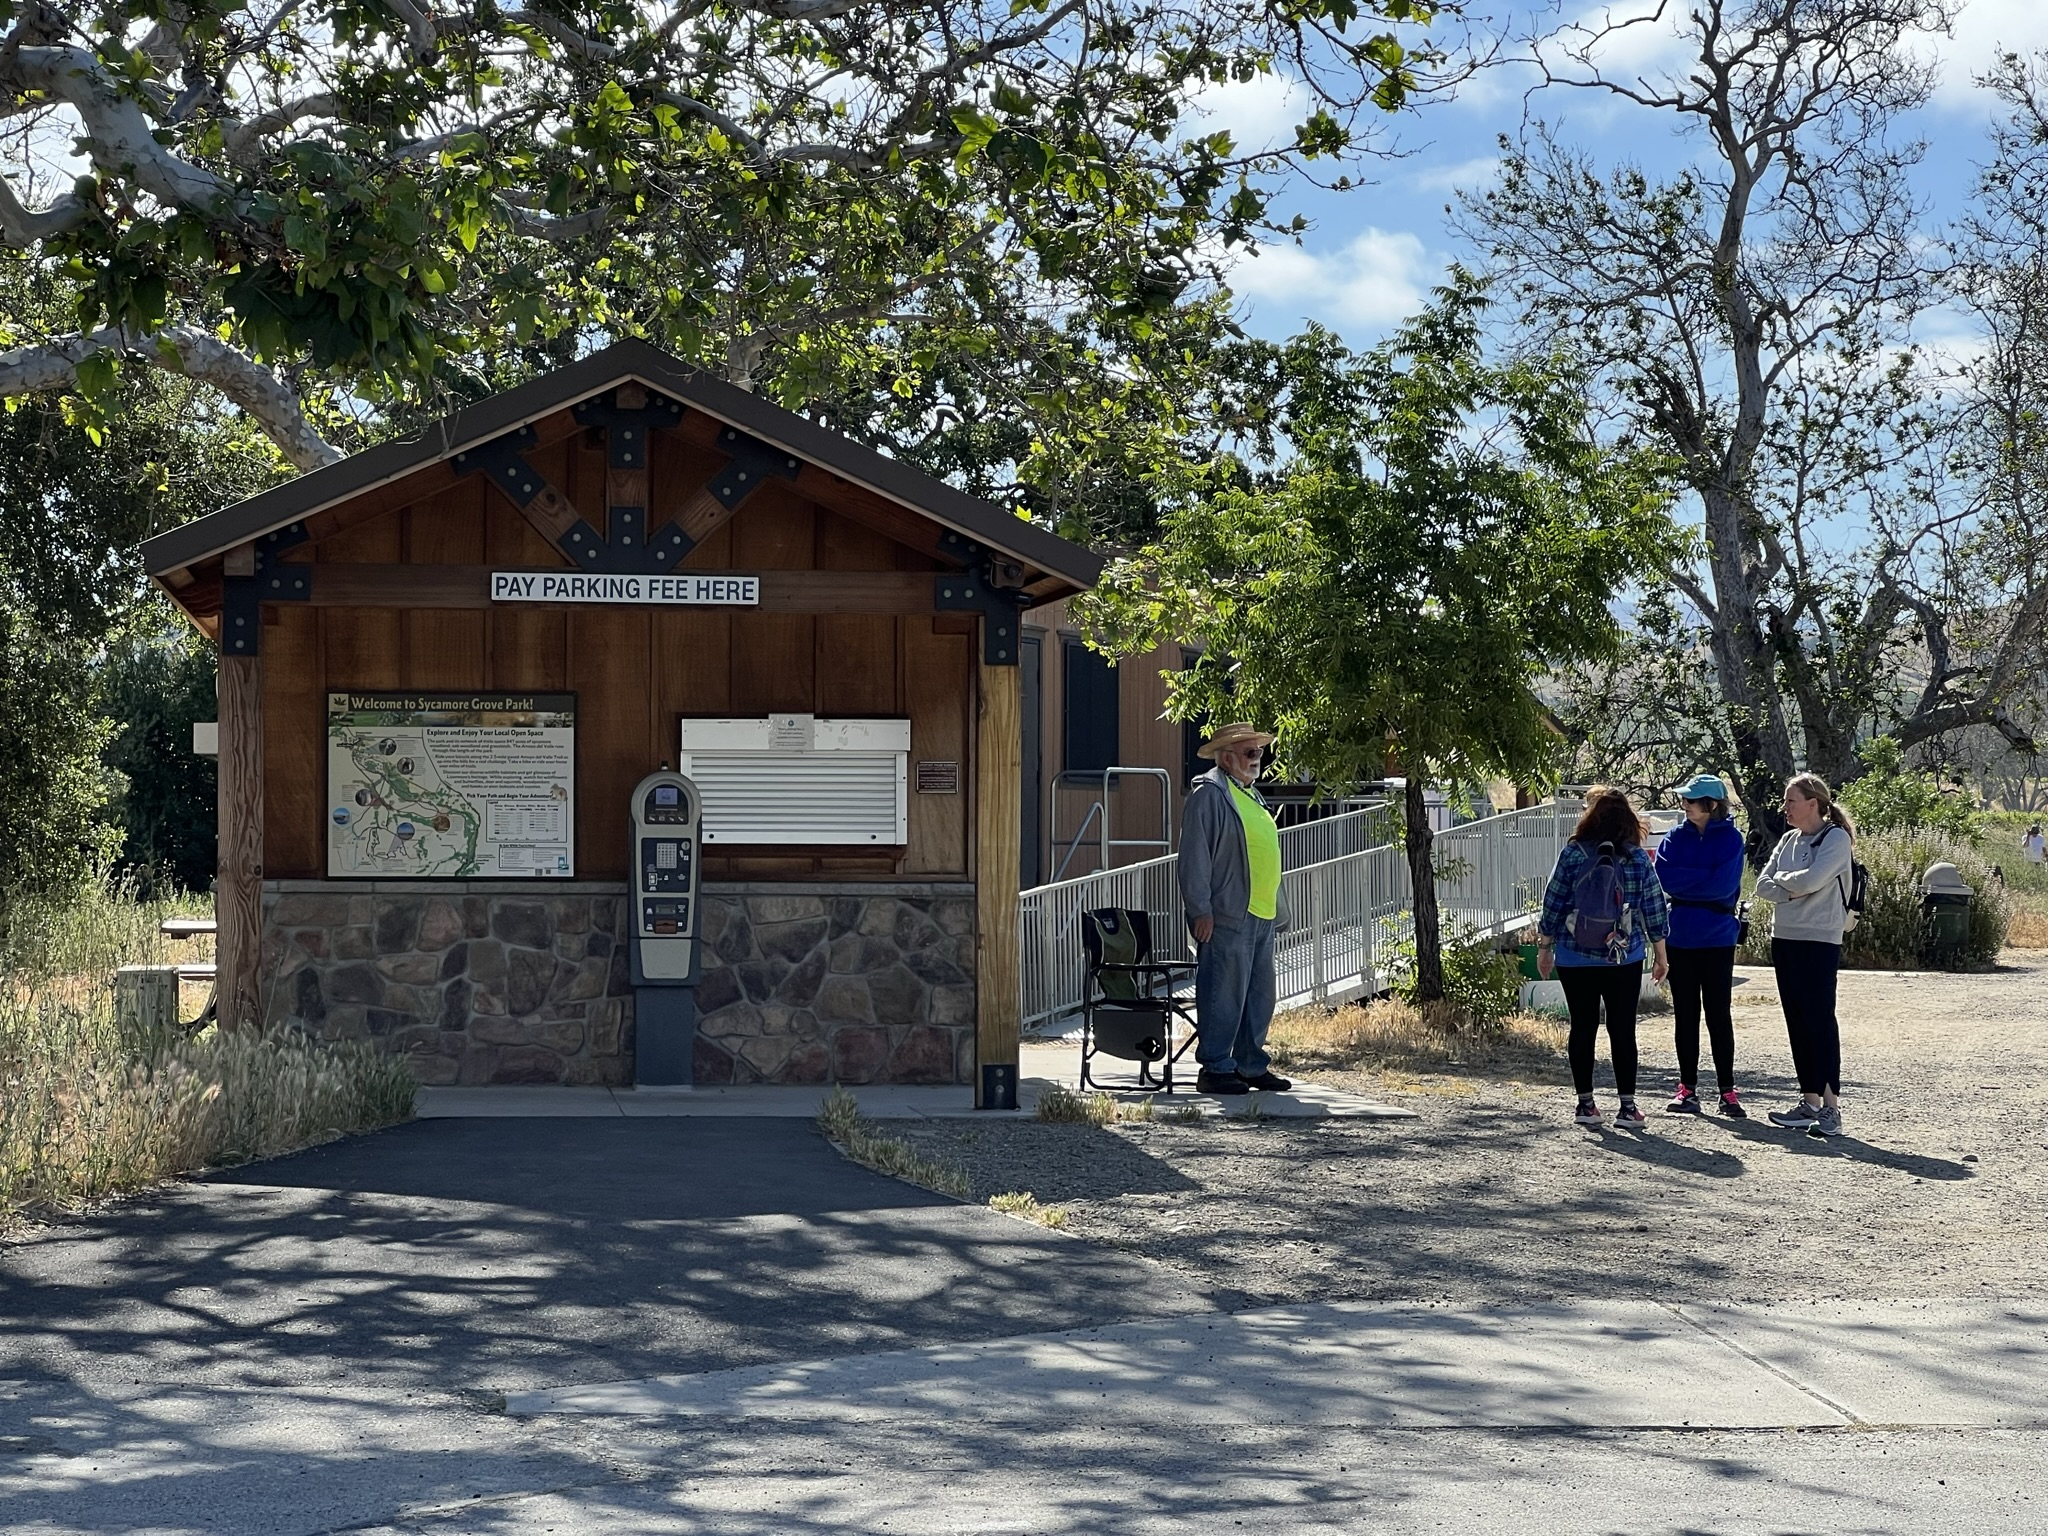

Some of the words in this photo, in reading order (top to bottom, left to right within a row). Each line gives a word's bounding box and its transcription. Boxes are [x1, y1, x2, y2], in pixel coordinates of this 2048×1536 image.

[495, 576, 536, 597] PAY
[542, 578, 641, 599] PARKING
[648, 579, 688, 600] FEE
[696, 580, 754, 600] HERE
[351, 698, 402, 710] Welcome
[404, 699, 416, 710] to
[418, 698, 468, 712] Sycamore
[472, 698, 503, 710] Grove
[506, 698, 534, 710] Park!
